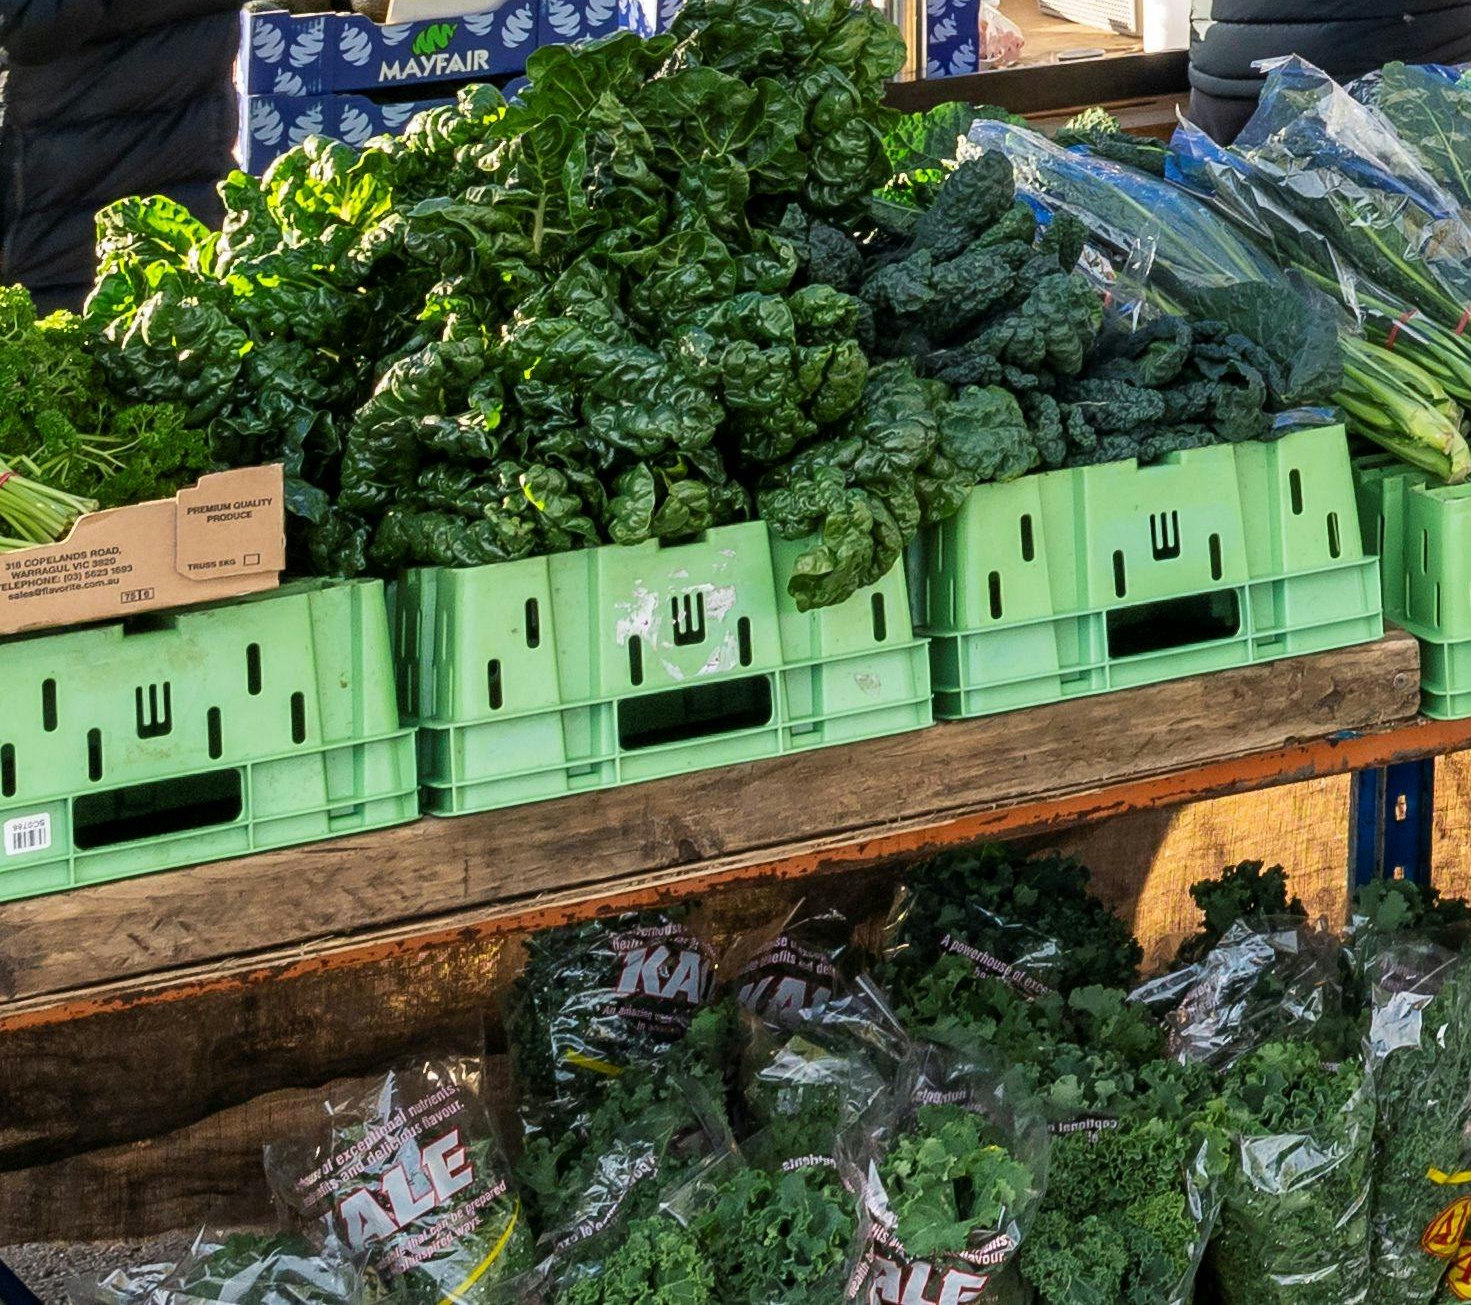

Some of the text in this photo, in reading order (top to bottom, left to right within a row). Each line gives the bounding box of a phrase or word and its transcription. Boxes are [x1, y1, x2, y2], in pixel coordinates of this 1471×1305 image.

[378, 49, 489, 82] MAYFAIR
[187, 498, 273, 516] PREMIUM QUALITY
[206, 511, 253, 523] PRODUCE
[11, 563, 71, 579] WARRAGUL
[73, 561, 90, 571] VIC
[24, 546, 122, 568] COPELANDS ROAD,
[187, 561, 215, 571] TRUSS
[64, 572, 82, 583] (03)
[950, 939, 1012, 977] powerhouse
[617, 945, 700, 1005] KA
[336, 1108, 408, 1165] exceptional
[341, 1159, 366, 1182] and
[421, 1098, 465, 1131] flavour.
[339, 1124, 475, 1253] ALE
[465, 1178, 507, 1215] prepared
